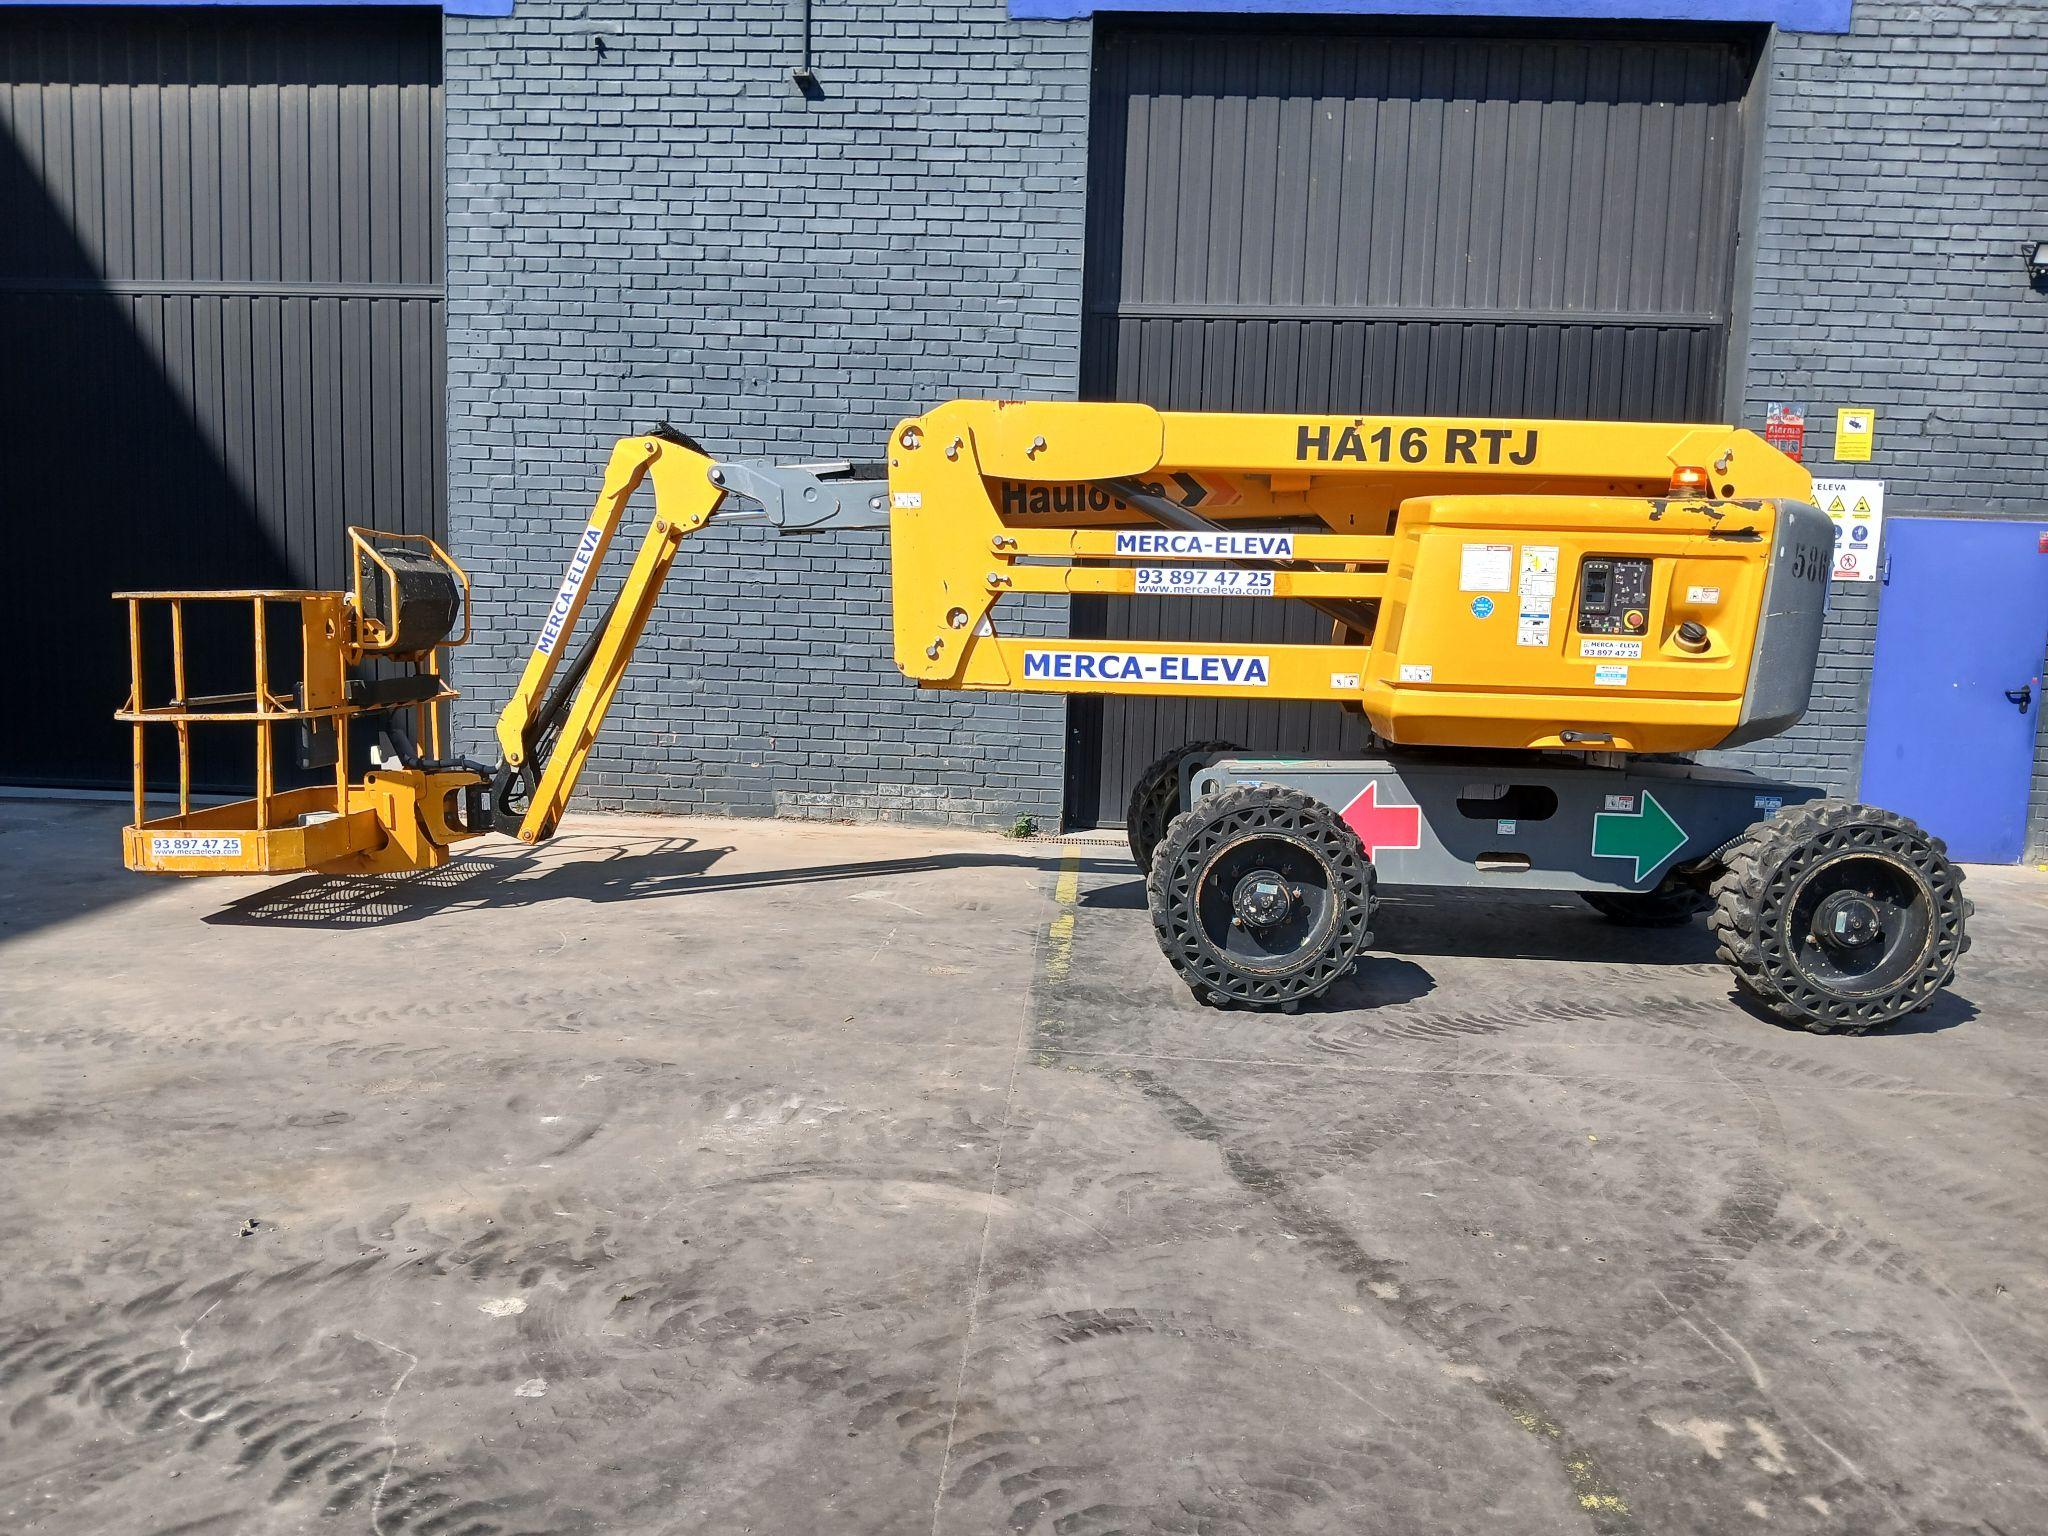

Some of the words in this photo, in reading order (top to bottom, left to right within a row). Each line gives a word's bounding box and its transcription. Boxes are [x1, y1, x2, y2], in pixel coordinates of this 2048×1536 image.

[1296, 425, 1428, 463] HA16
[1444, 428, 1539, 465] RTJ
[1001, 480, 1167, 515] Haulo
[1817, 483, 1846, 491] ELEVA
[1117, 534, 1291, 556] MERCA-ELEVA
[1138, 569, 1163, 584] 93
[1170, 570, 1207, 585] 897
[1214, 571, 1240, 586] 47
[1247, 572, 1272, 587] 25
[538, 530, 601, 654] MERCA-ELEVA
[1138, 584, 1272, 596] www.mercaeleva.com
[1024, 653, 1267, 682] MERCA-ELEVA
[153, 839, 170, 849] 93
[174, 839, 198, 849] 897
[202, 839, 218, 849] 47
[223, 839, 239, 849] 25
